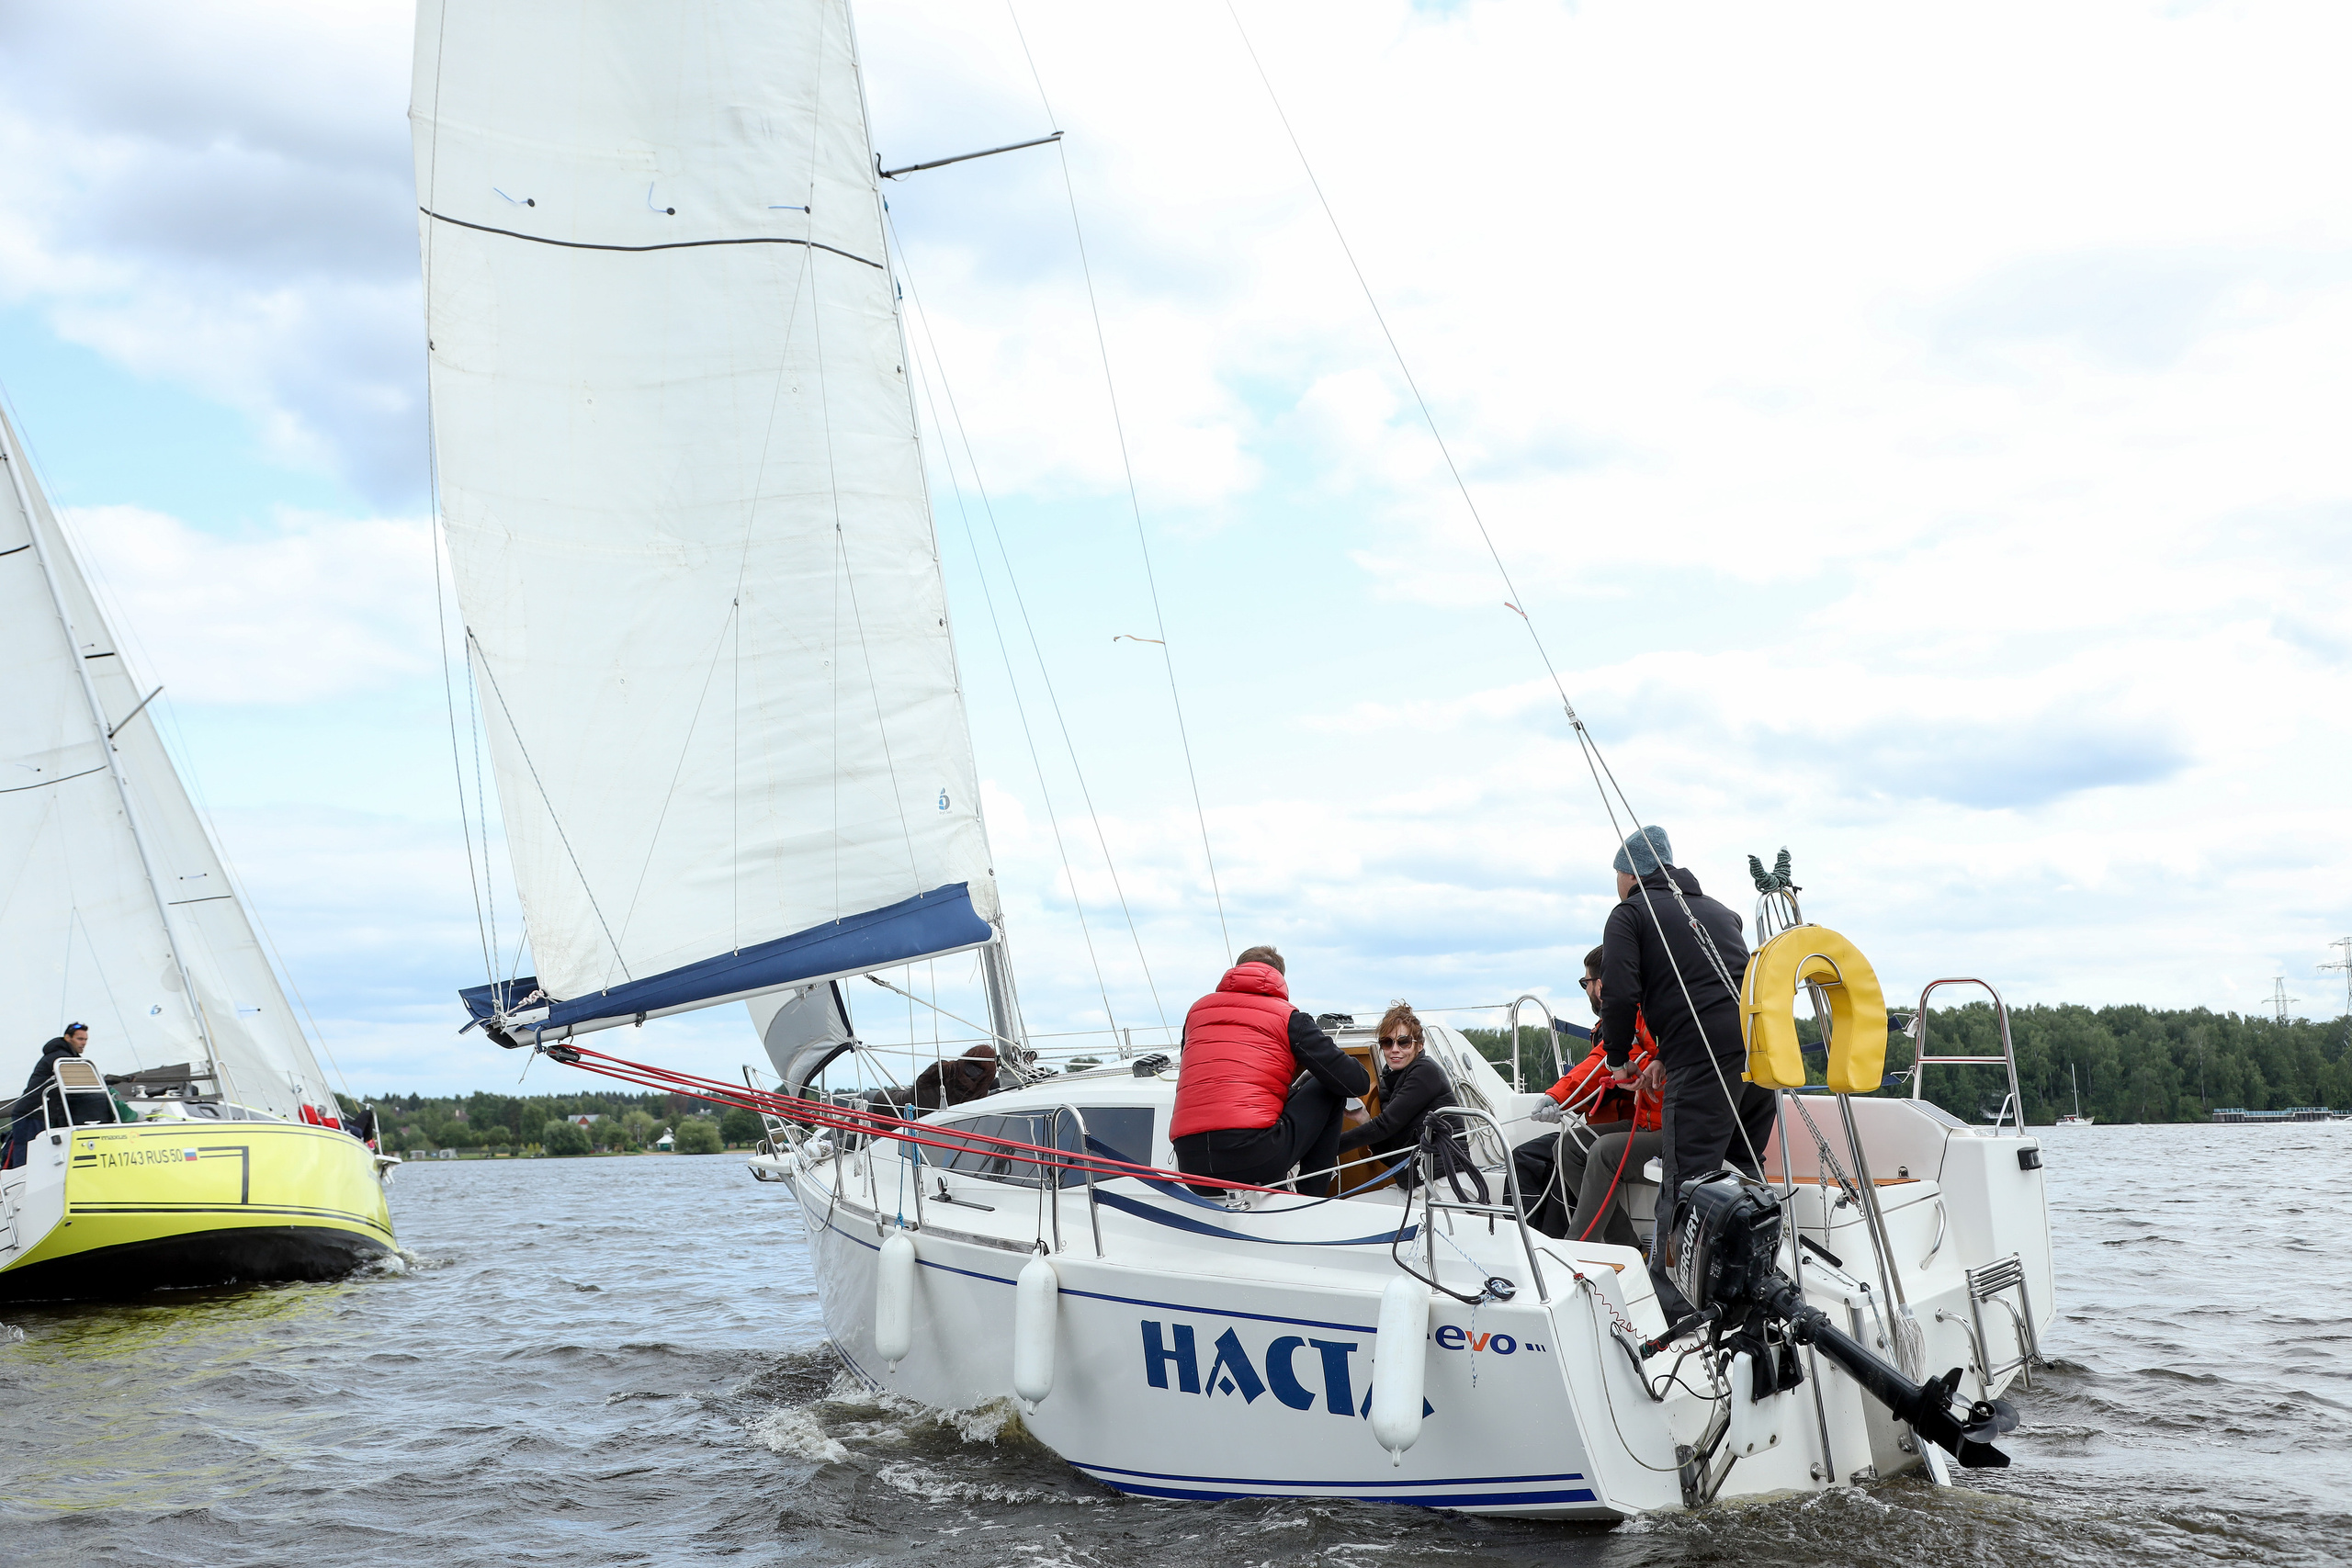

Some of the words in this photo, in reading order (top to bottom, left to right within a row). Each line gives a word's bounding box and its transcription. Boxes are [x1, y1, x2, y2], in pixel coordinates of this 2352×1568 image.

[1679, 1204, 1701, 1295] MERCURY
[1140, 1319, 1435, 1421] НАСТ
[1435, 1325, 1517, 1355] evo
